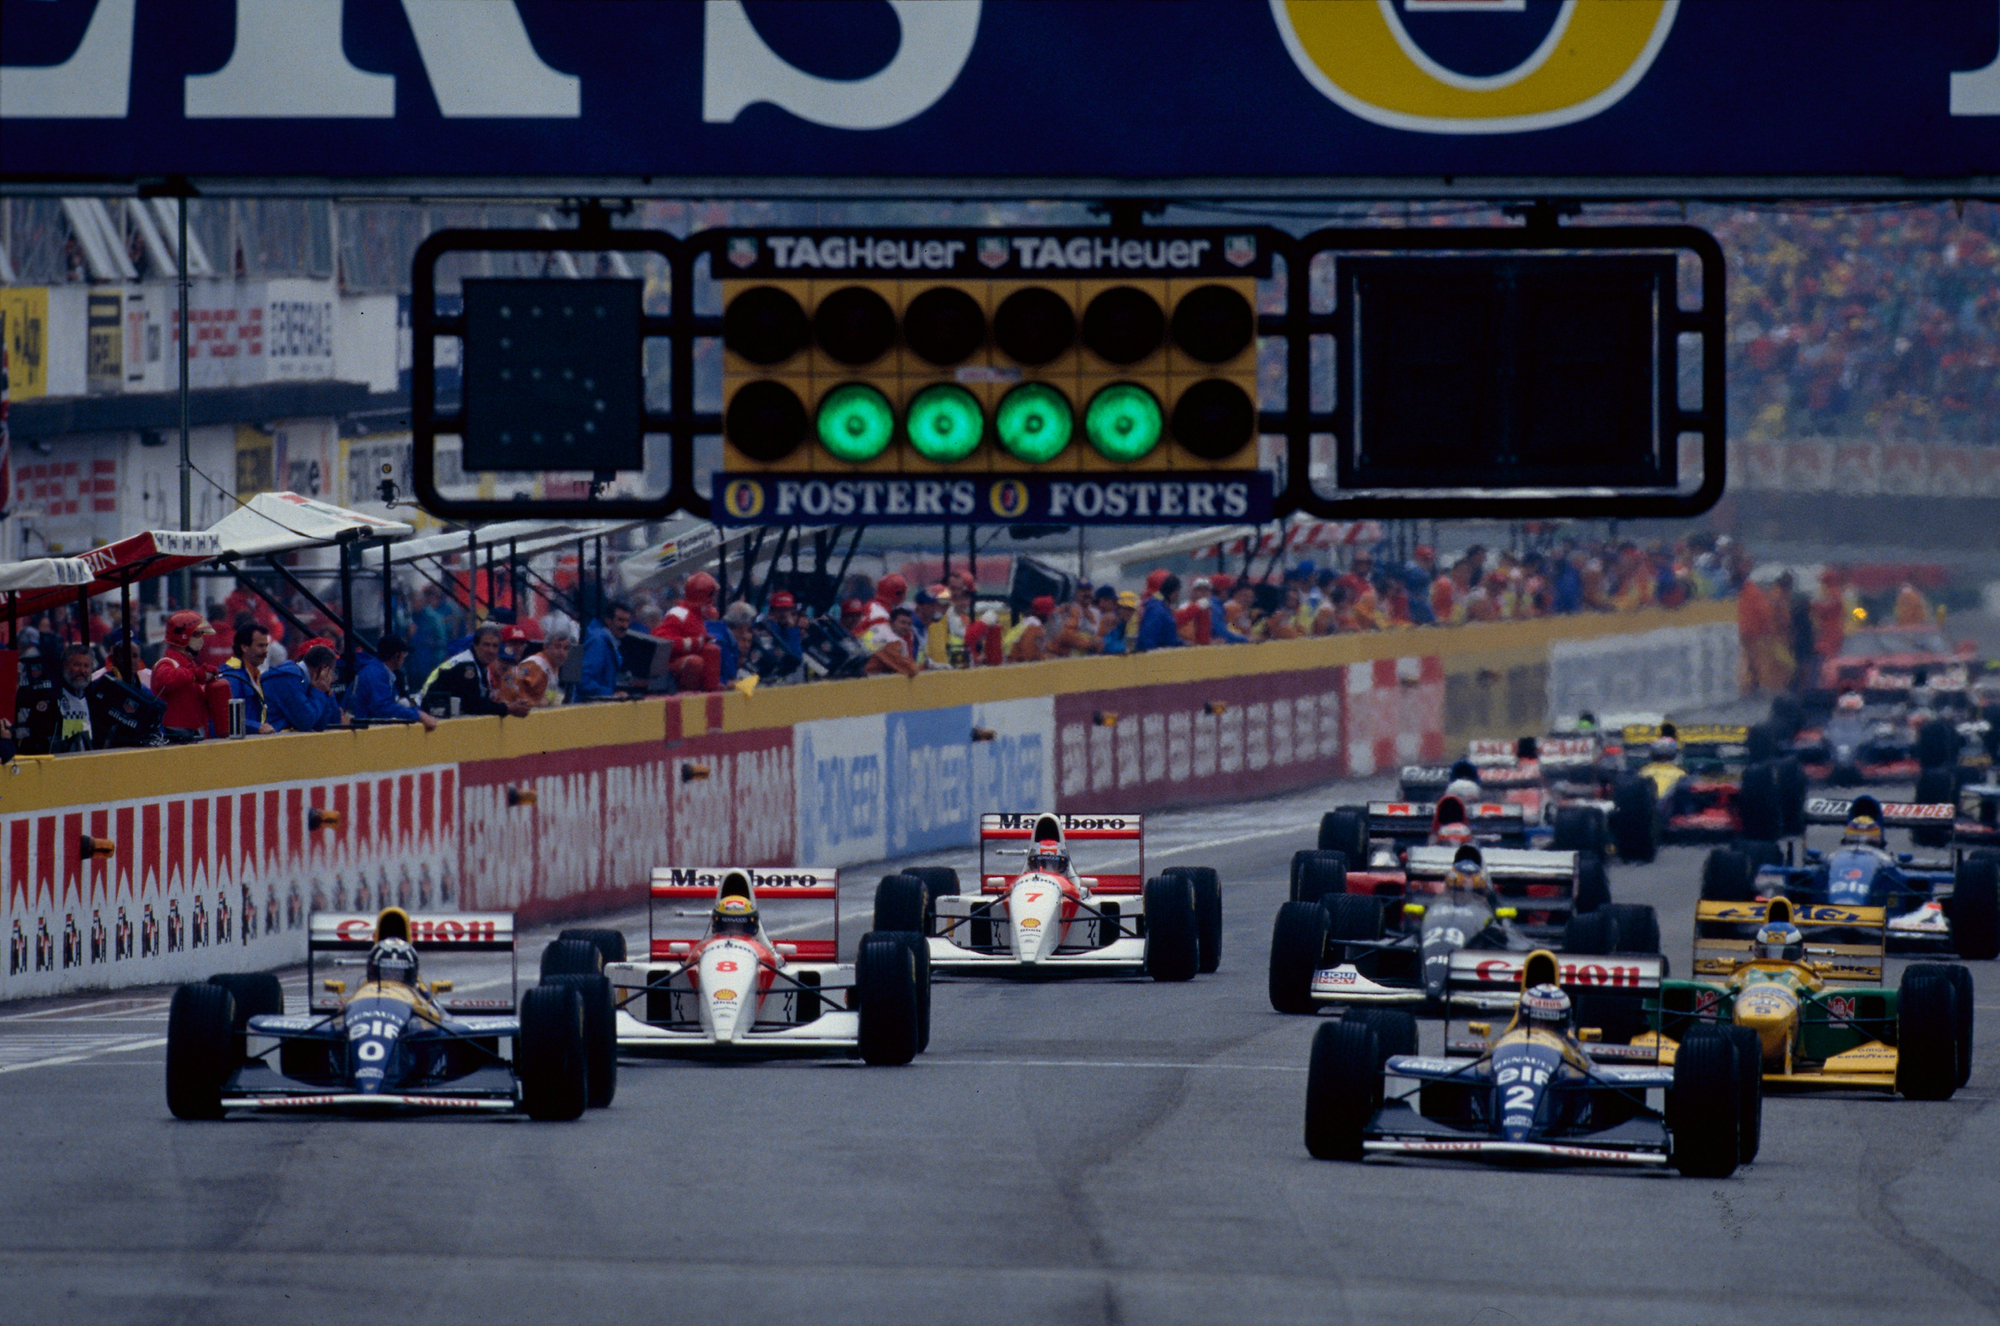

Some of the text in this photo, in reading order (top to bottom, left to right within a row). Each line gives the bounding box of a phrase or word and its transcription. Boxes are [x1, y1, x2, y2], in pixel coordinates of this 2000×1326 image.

[776, 480, 1247, 517] FOSTER'S FOSTER'S
[1882, 803, 1954, 818] BLONDES
[999, 814, 1126, 830] Maboro
[670, 868, 818, 887] Maboro
[1024, 892, 1043, 903] 7
[335, 919, 495, 941] Cnon
[1422, 926, 1465, 948] 29
[715, 960, 738, 973] 8
[1319, 976, 1355, 985] MOLY
[1320, 971, 1357, 980] LIQUI
[450, 998, 508, 1007] Canon
[357, 1040, 385, 1062] 0
[1591, 1045, 1653, 1057] Canon
[258, 1094, 334, 1107] Canon
[402, 1094, 479, 1108] Canon
[1504, 1084, 1535, 1111] 2
[1550, 1145, 1630, 1160] Canon
